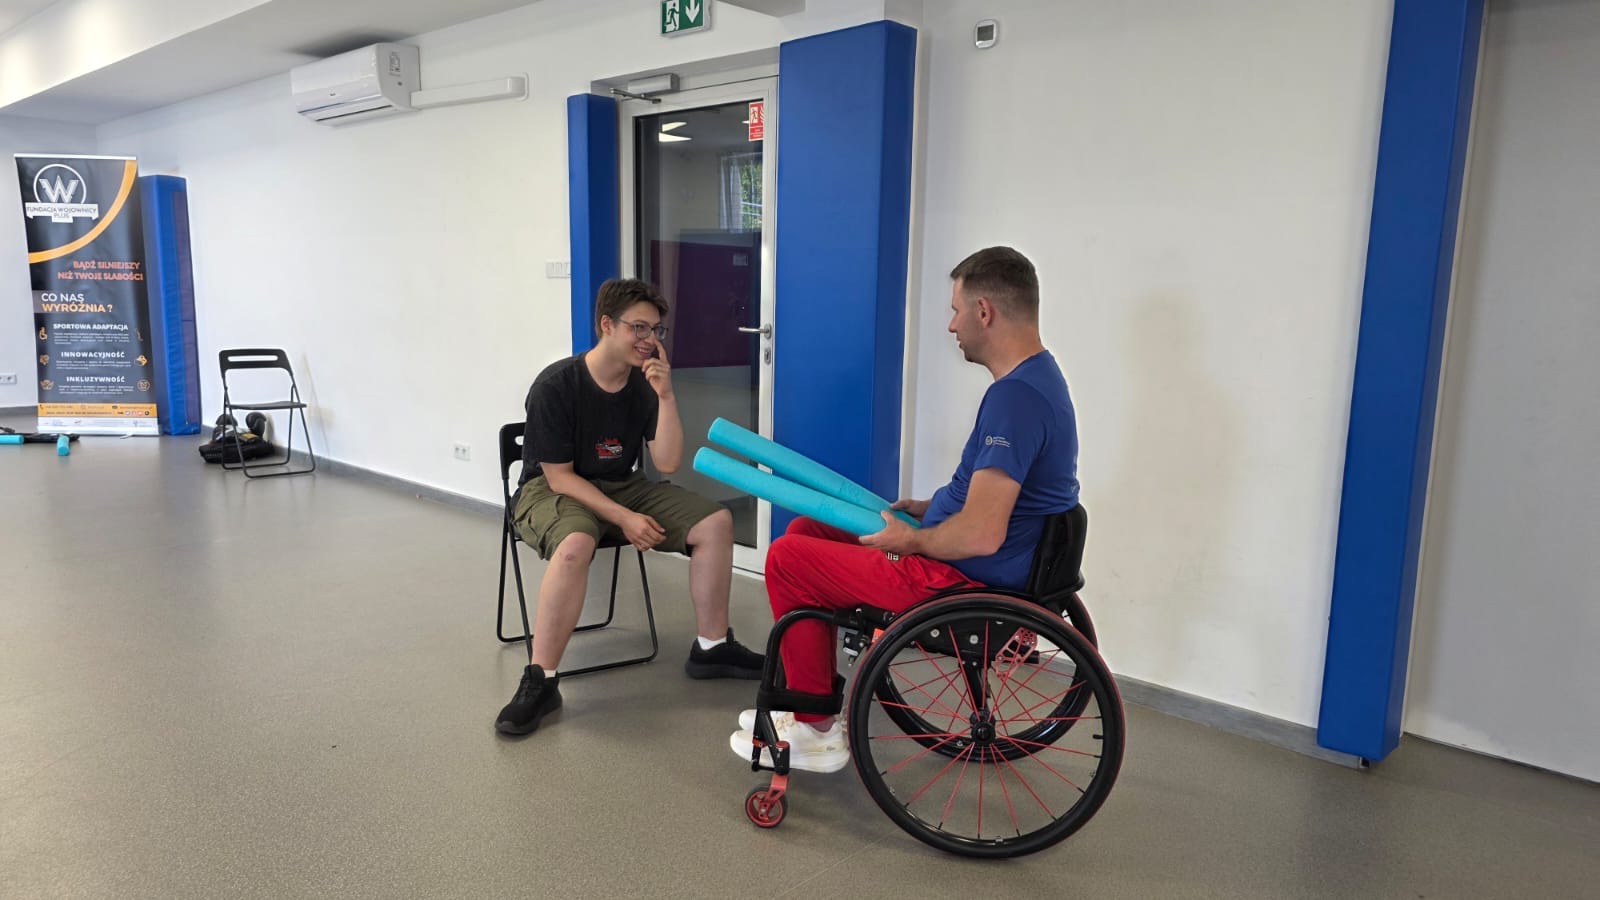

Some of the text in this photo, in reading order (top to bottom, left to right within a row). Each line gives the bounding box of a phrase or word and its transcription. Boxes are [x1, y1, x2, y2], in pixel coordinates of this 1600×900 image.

[39, 175, 80, 203] W
[73, 260, 140, 270] BĄDŹ SILNIEJSZY
[57, 270, 144, 280] NIŻ TWOJE SŁABOŚCI
[41, 293, 85, 302] CO NAS
[42, 301, 106, 312] WYRÓŻNIA
[61, 351, 125, 359] INNOWACYJNOŚĆ
